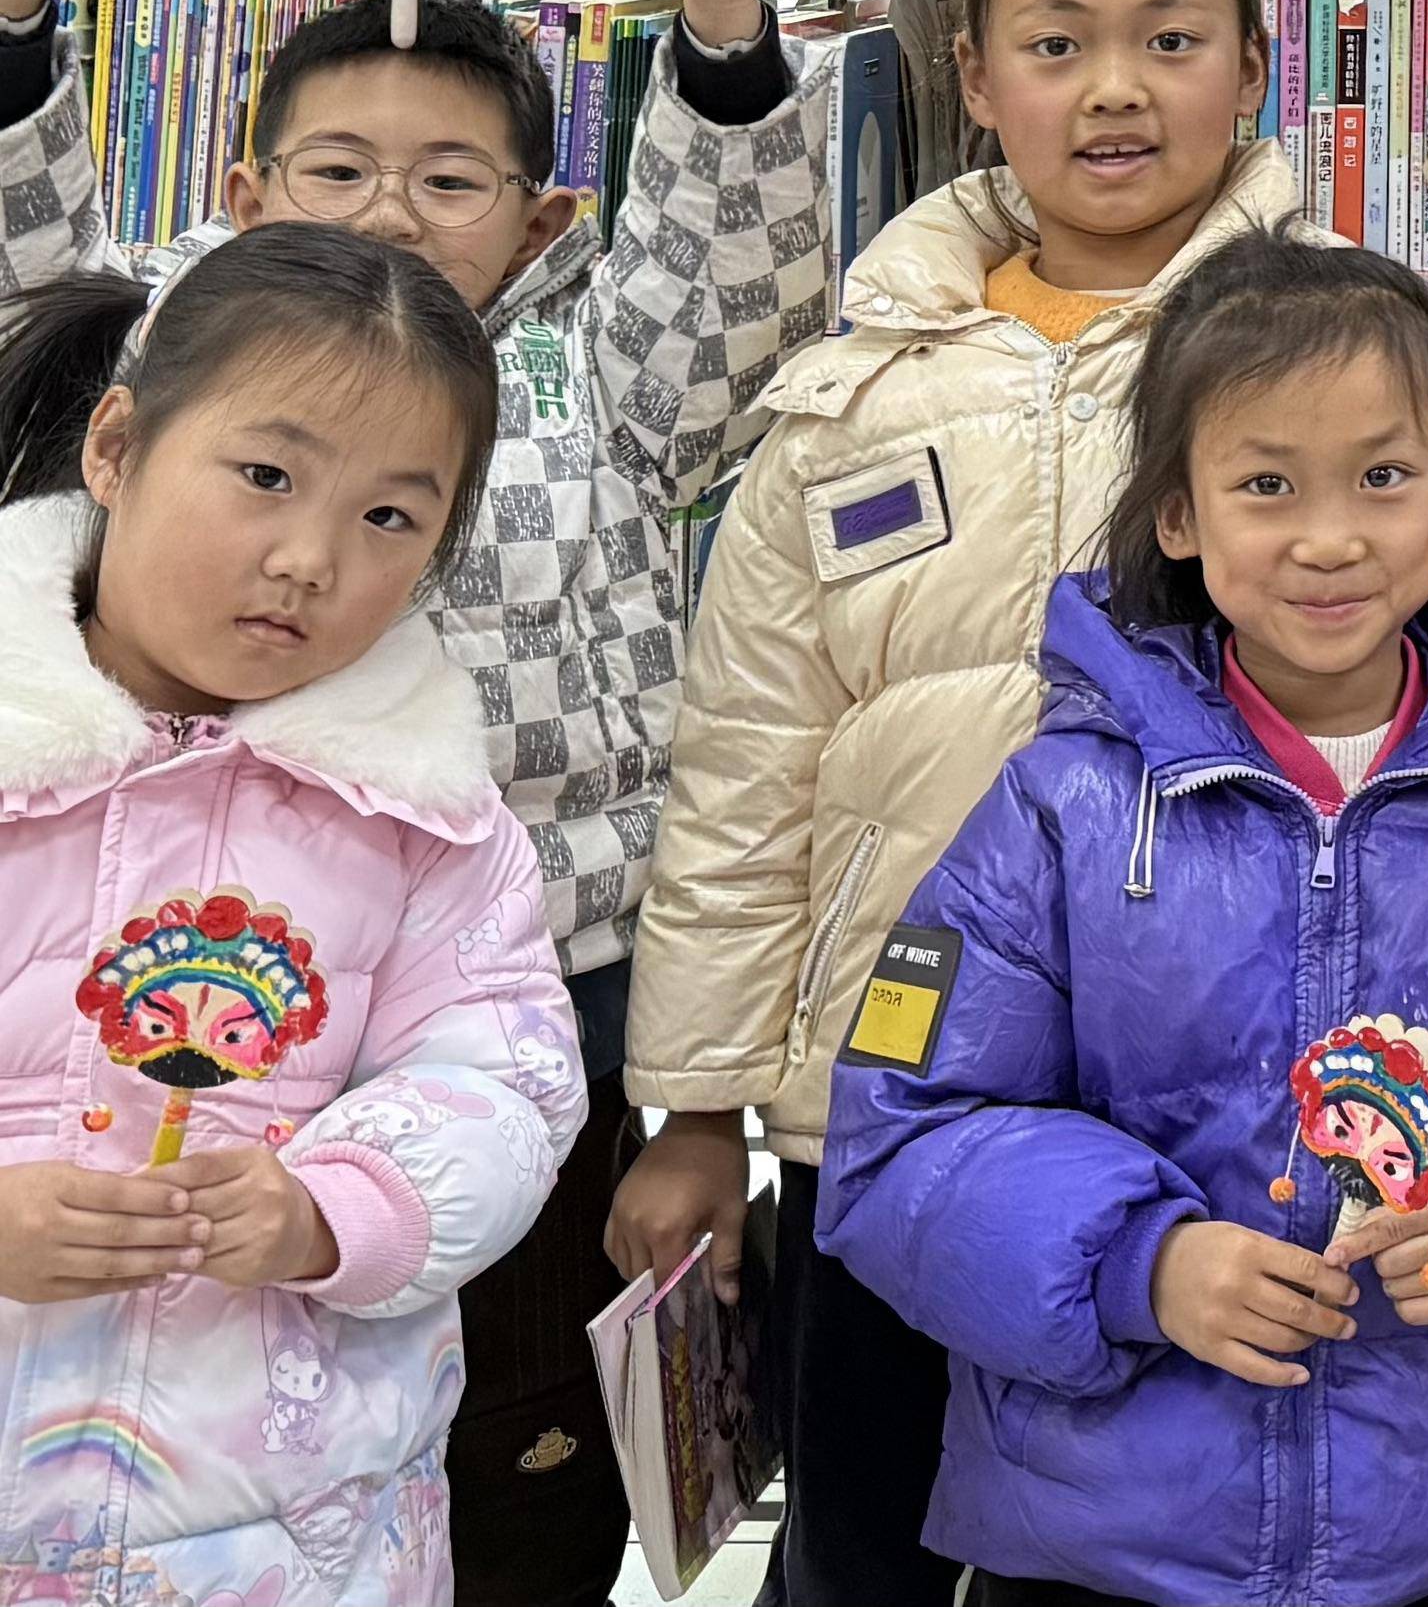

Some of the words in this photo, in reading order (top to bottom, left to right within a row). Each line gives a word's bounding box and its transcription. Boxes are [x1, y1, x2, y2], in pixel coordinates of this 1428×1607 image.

[583, 63, 606, 179] 笑翻你的英文故事
[1343, 116, 1357, 167] 西游记
